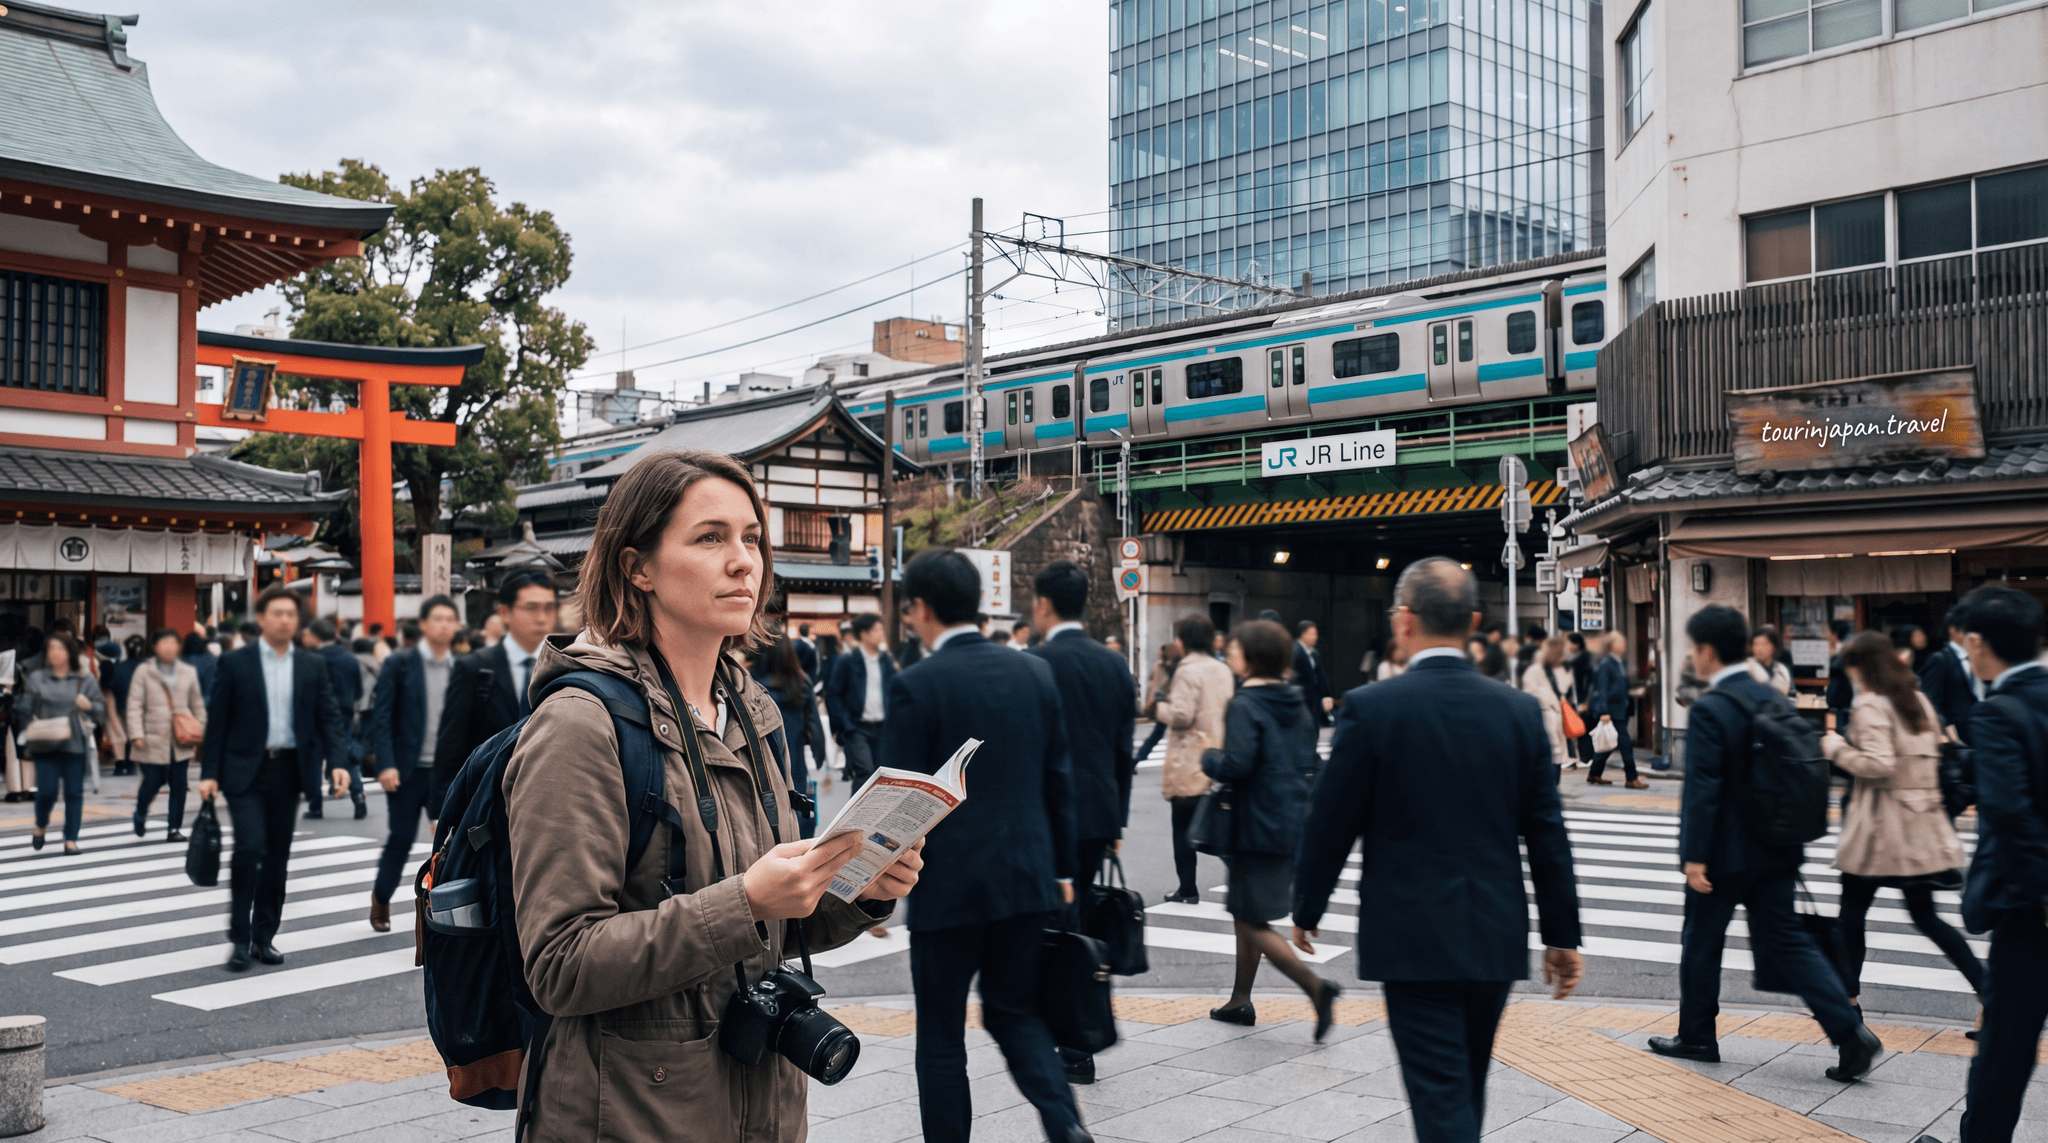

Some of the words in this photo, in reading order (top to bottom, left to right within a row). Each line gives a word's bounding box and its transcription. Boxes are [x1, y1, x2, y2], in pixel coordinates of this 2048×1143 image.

[1112, 375, 1124, 386] JR
[1762, 408, 1948, 448] tourinjapan.travel
[1268, 447, 1297, 470] JR
[1305, 445, 1331, 466] JR
[1340, 441, 1385, 462] Line
